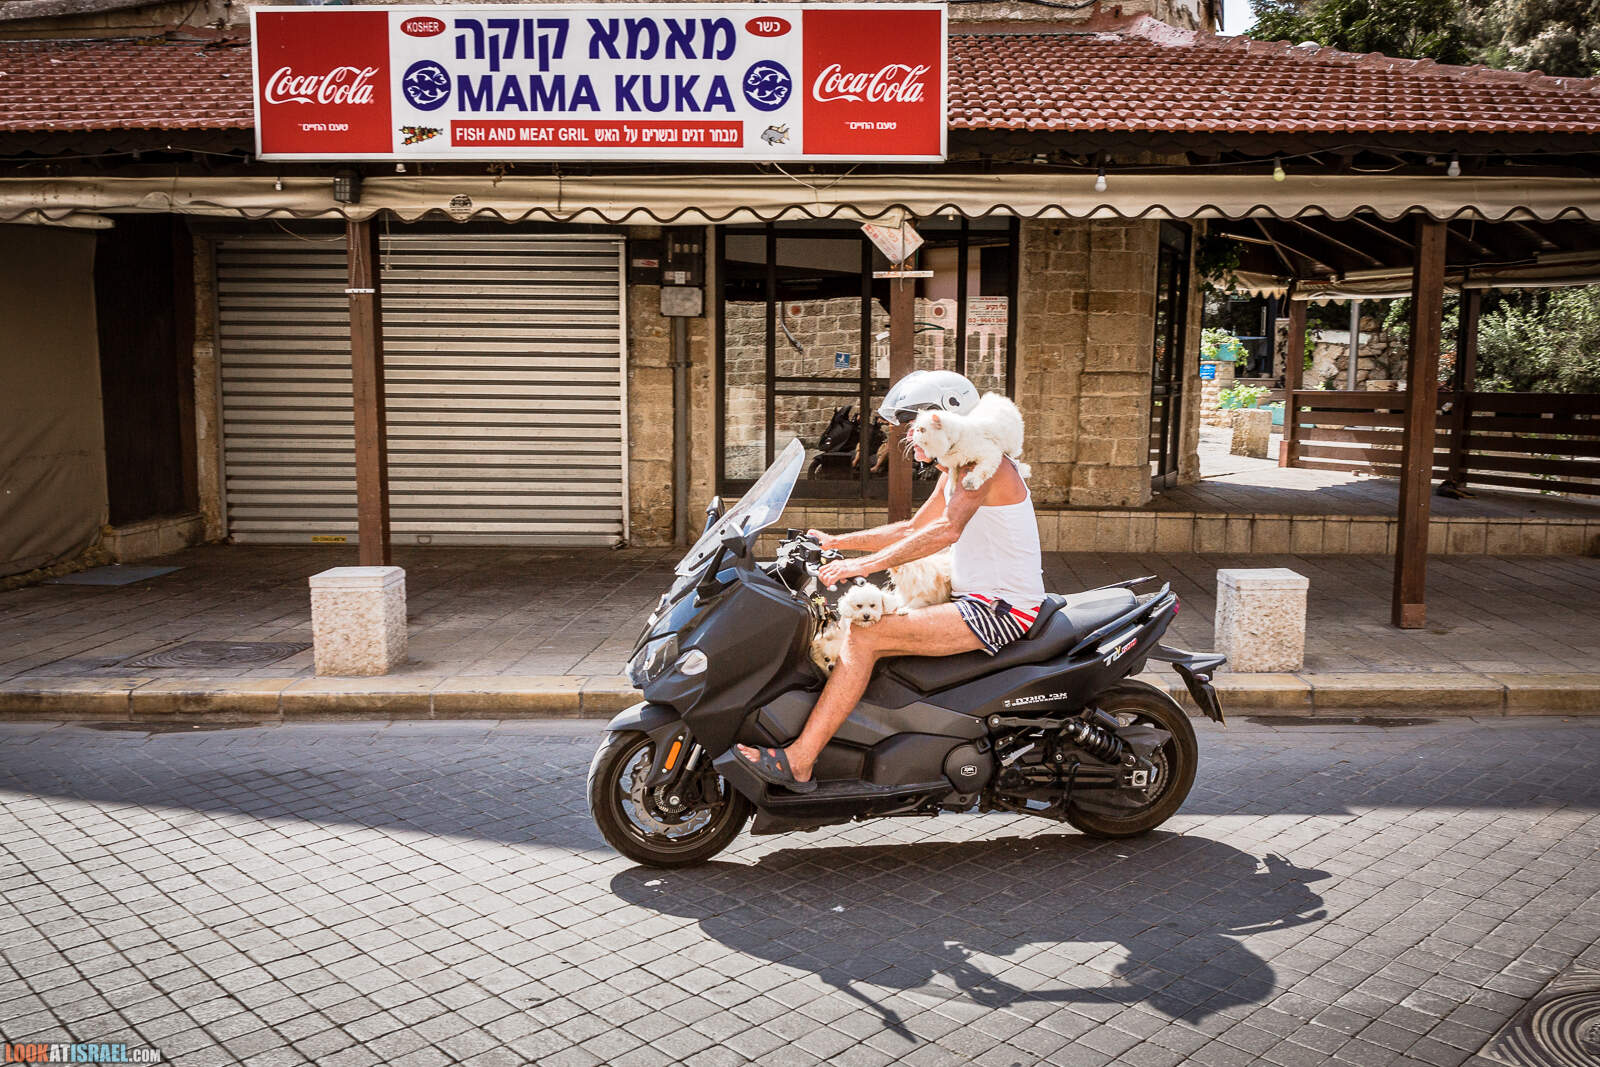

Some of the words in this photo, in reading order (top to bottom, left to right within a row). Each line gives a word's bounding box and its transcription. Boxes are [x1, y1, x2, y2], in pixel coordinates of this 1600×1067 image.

[406, 21, 440, 33] KOSHER
[756, 21, 781, 33] כשר
[454, 18, 570, 72] קוקה
[586, 17, 737, 61] מאמא
[264, 66, 379, 105] Coca-Cola
[812, 63, 931, 103] Coca-Cola
[457, 74, 602, 112] MAMA
[614, 74, 736, 113] KUKA
[328, 123, 349, 131] טעם
[875, 121, 897, 130] טעם
[455, 127, 485, 141] FISH
[488, 127, 516, 141] AND
[519, 127, 555, 141] MEAT
[558, 127, 590, 141] GRIL
[594, 128, 620, 142] האש
[623, 124, 638, 144] על
[641, 128, 678, 142] ובשרים
[681, 128, 705, 142] דגים
[708, 128, 739, 143] מבחר
